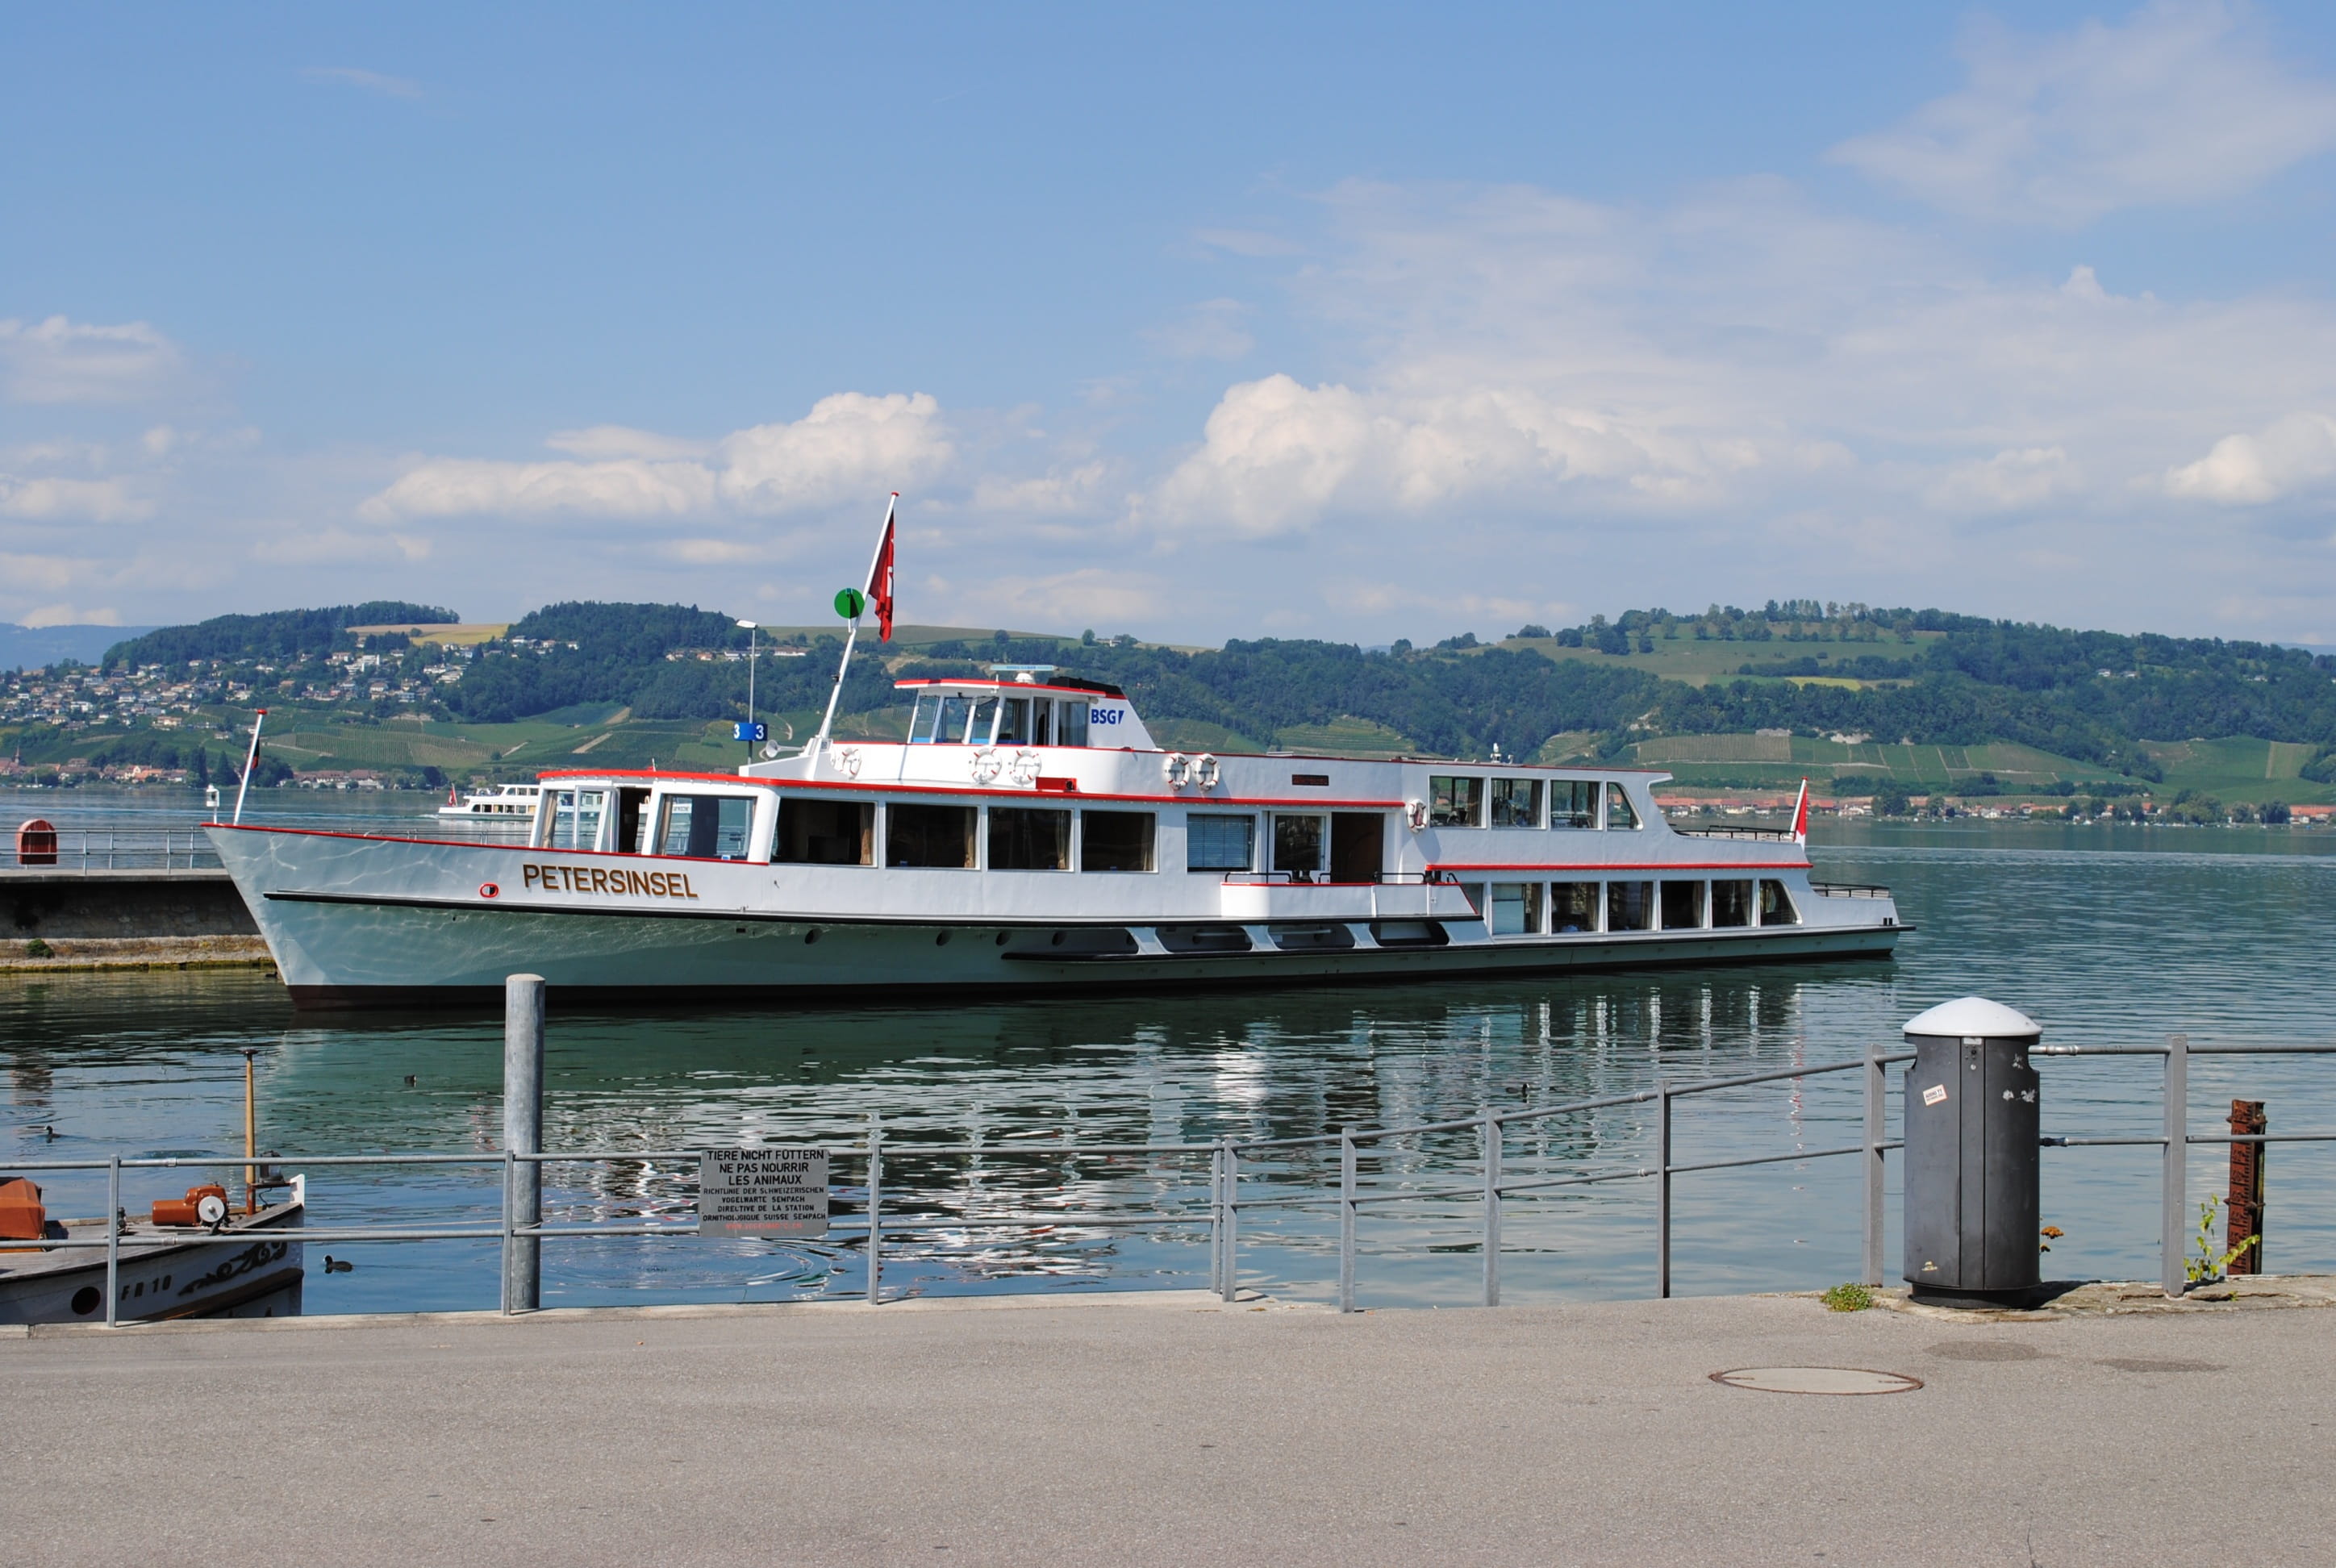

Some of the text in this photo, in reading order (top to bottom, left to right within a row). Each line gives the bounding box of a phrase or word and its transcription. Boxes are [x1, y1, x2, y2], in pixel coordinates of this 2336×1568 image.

[1091, 708, 1116, 725] BSG
[733, 723, 740, 740] 3
[755, 724, 764, 740] 3
[523, 864, 699, 899] PETERSINSEL
[707, 1150, 738, 1161] TIERE
[741, 1150, 773, 1160] NICHT
[720, 1162, 809, 1173] NE PAS NOURRIR
[728, 1174, 802, 1186] LES ANIMAUX
[793, 1212, 826, 1220] SEMPACH
